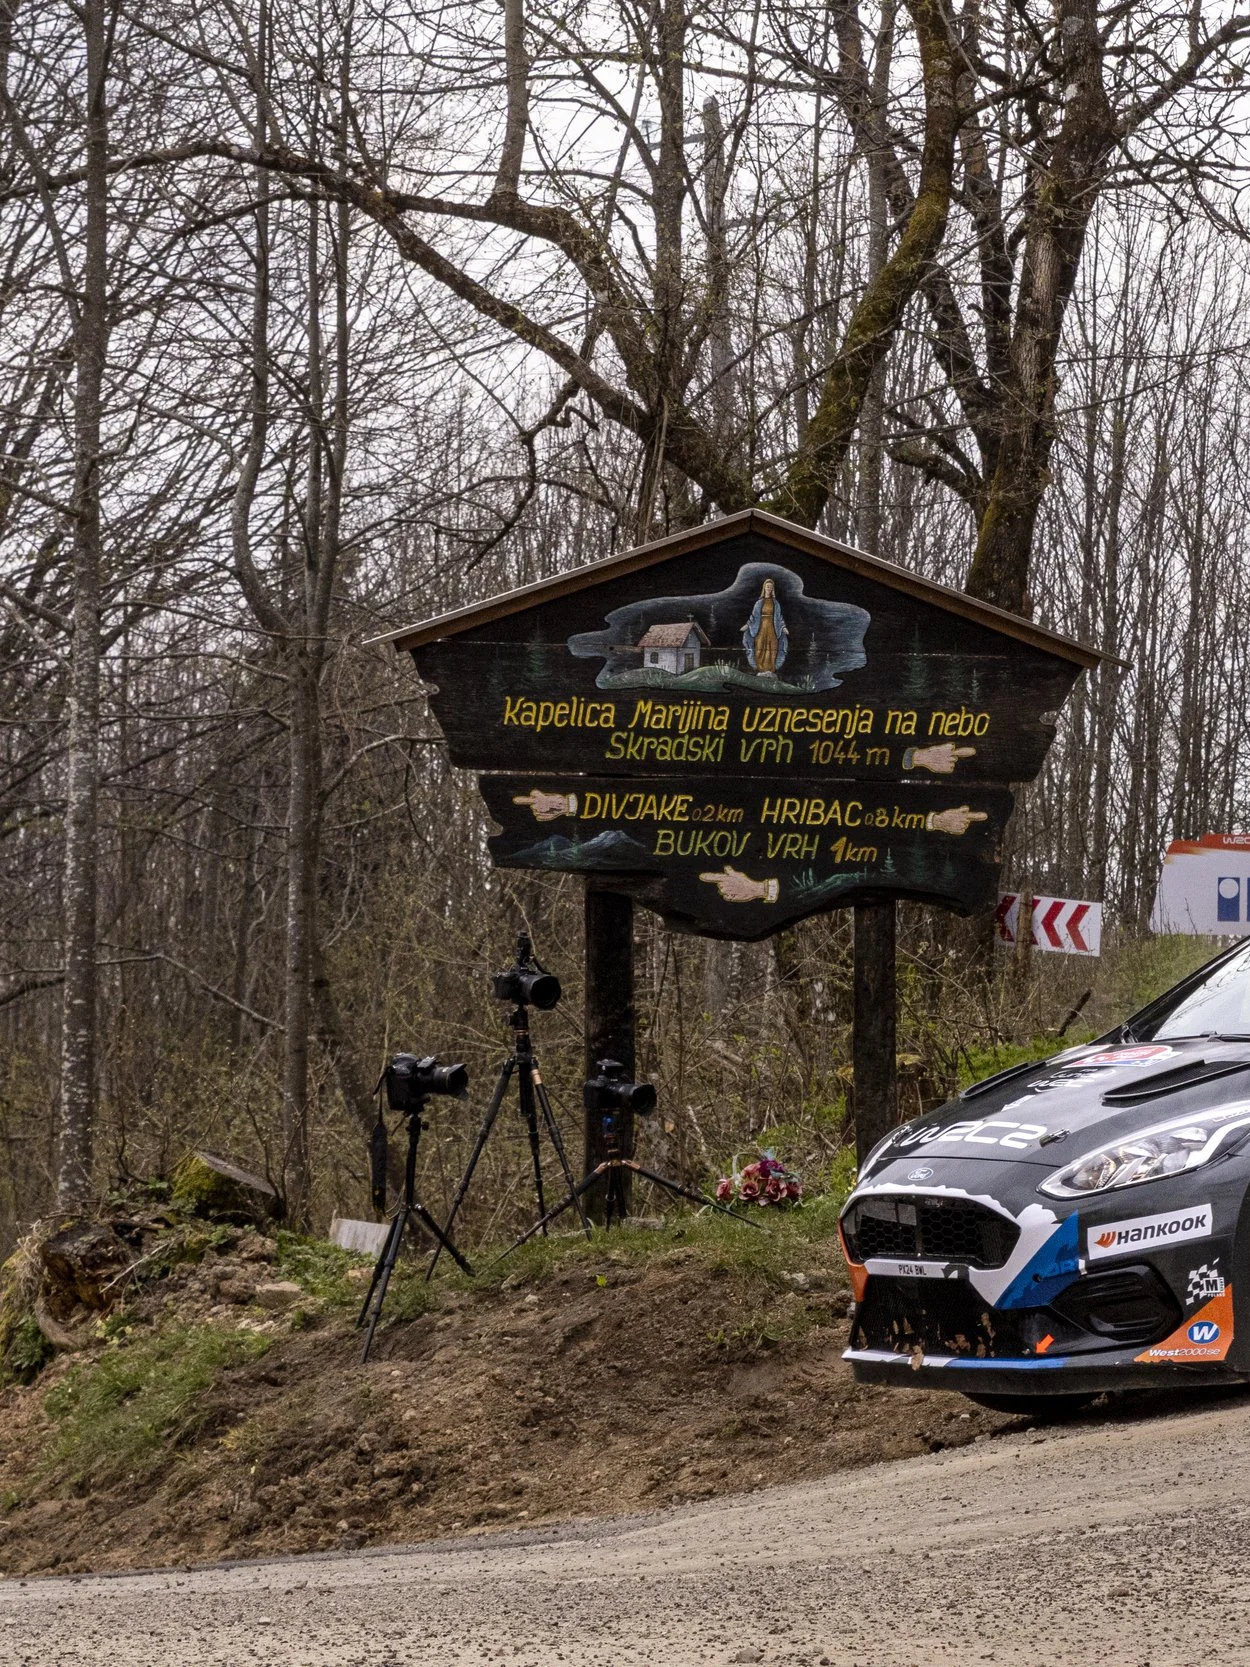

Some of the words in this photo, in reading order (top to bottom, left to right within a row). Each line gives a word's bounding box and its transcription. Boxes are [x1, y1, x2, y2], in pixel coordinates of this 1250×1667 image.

[503, 695, 616, 732] Kapelica
[628, 698, 730, 734] Marijina
[884, 709, 918, 736] na
[927, 705, 990, 737] nebo
[605, 731, 726, 762] Skradski
[739, 734, 794, 764] vrh
[808, 739, 861, 766] 1044
[865, 746, 890, 766] m
[579, 791, 694, 822] DIVJAKE
[760, 796, 863, 828] HRIBAC
[652, 829, 751, 857] BUKOV
[767, 831, 820, 860] VRH
[900, 1119, 1048, 1150] WRC2
